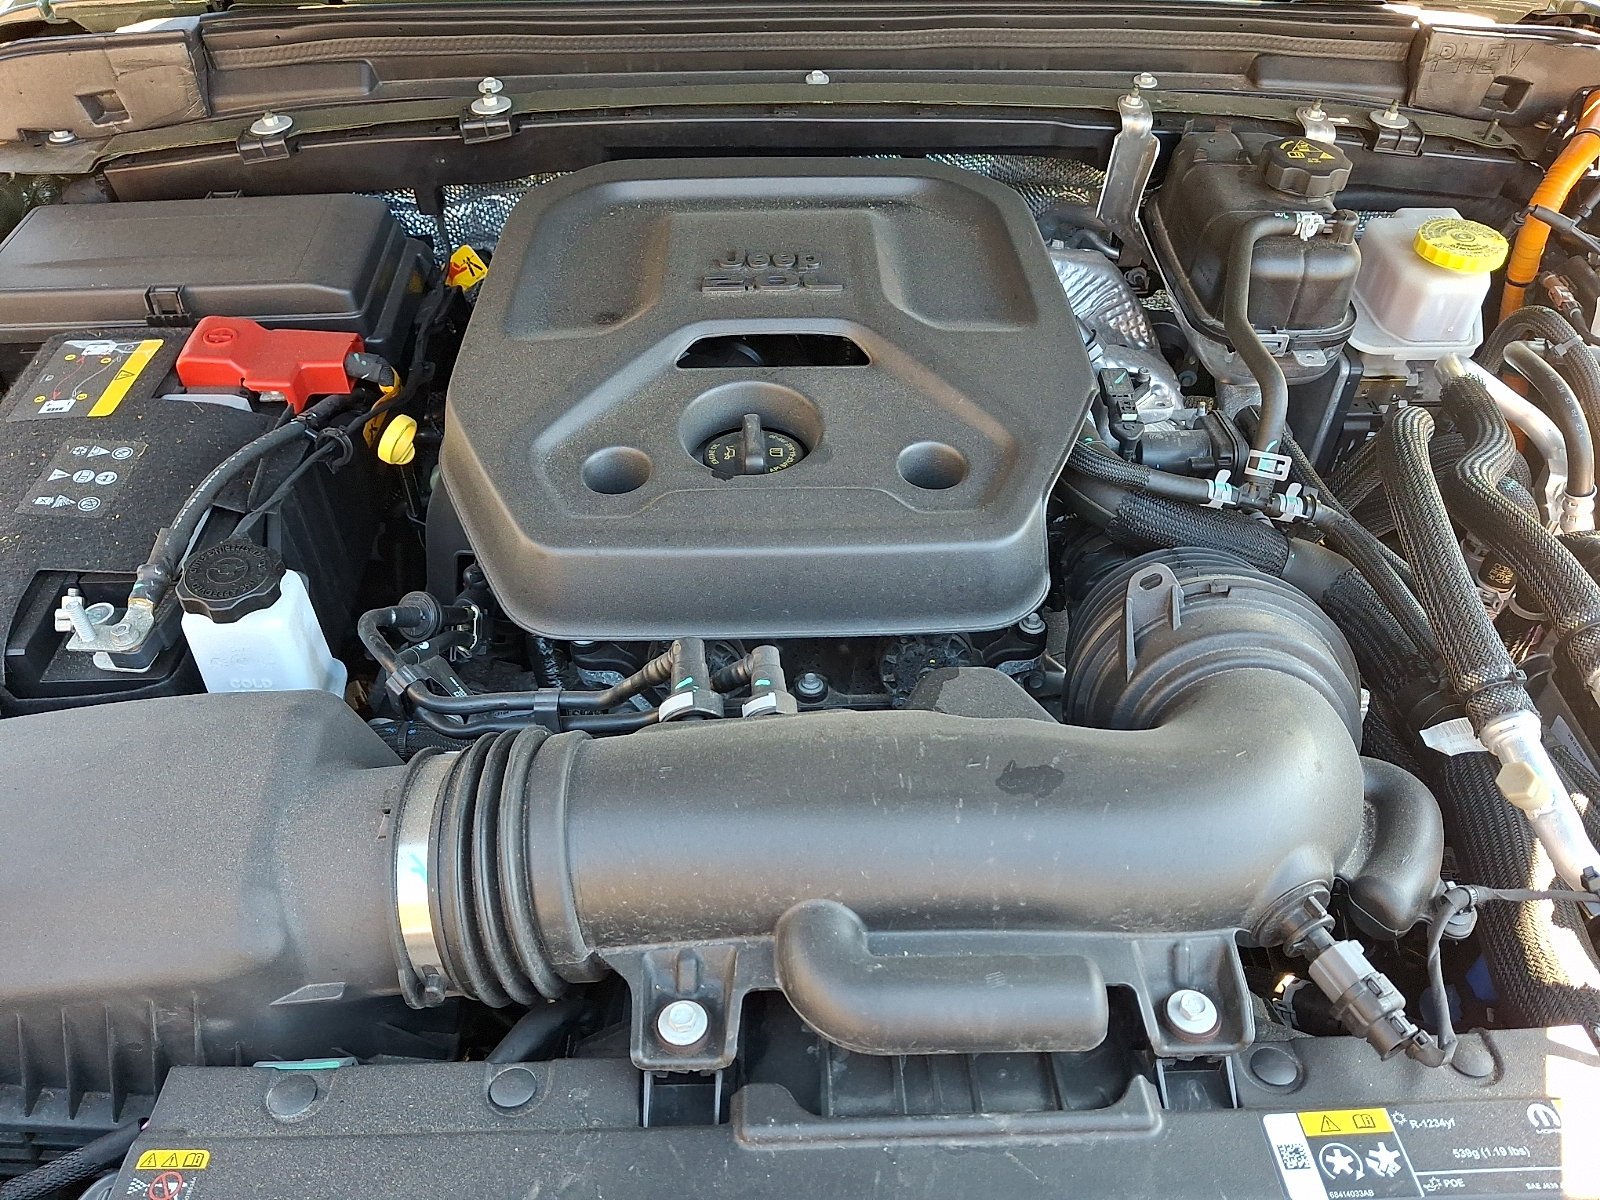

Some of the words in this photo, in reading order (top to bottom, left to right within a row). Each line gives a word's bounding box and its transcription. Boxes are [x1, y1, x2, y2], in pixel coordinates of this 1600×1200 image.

[1430, 42, 1534, 75] PHEV
[712, 249, 822, 273] Jeep
[191, 582, 238, 597] APPROVED
[230, 678, 273, 689] COLD
[1452, 1148, 1480, 1160] 539g
[1481, 1146, 1507, 1159] (1.19
[1508, 1146, 1530, 1158] lbs)
[1444, 1178, 1466, 1188] POE
